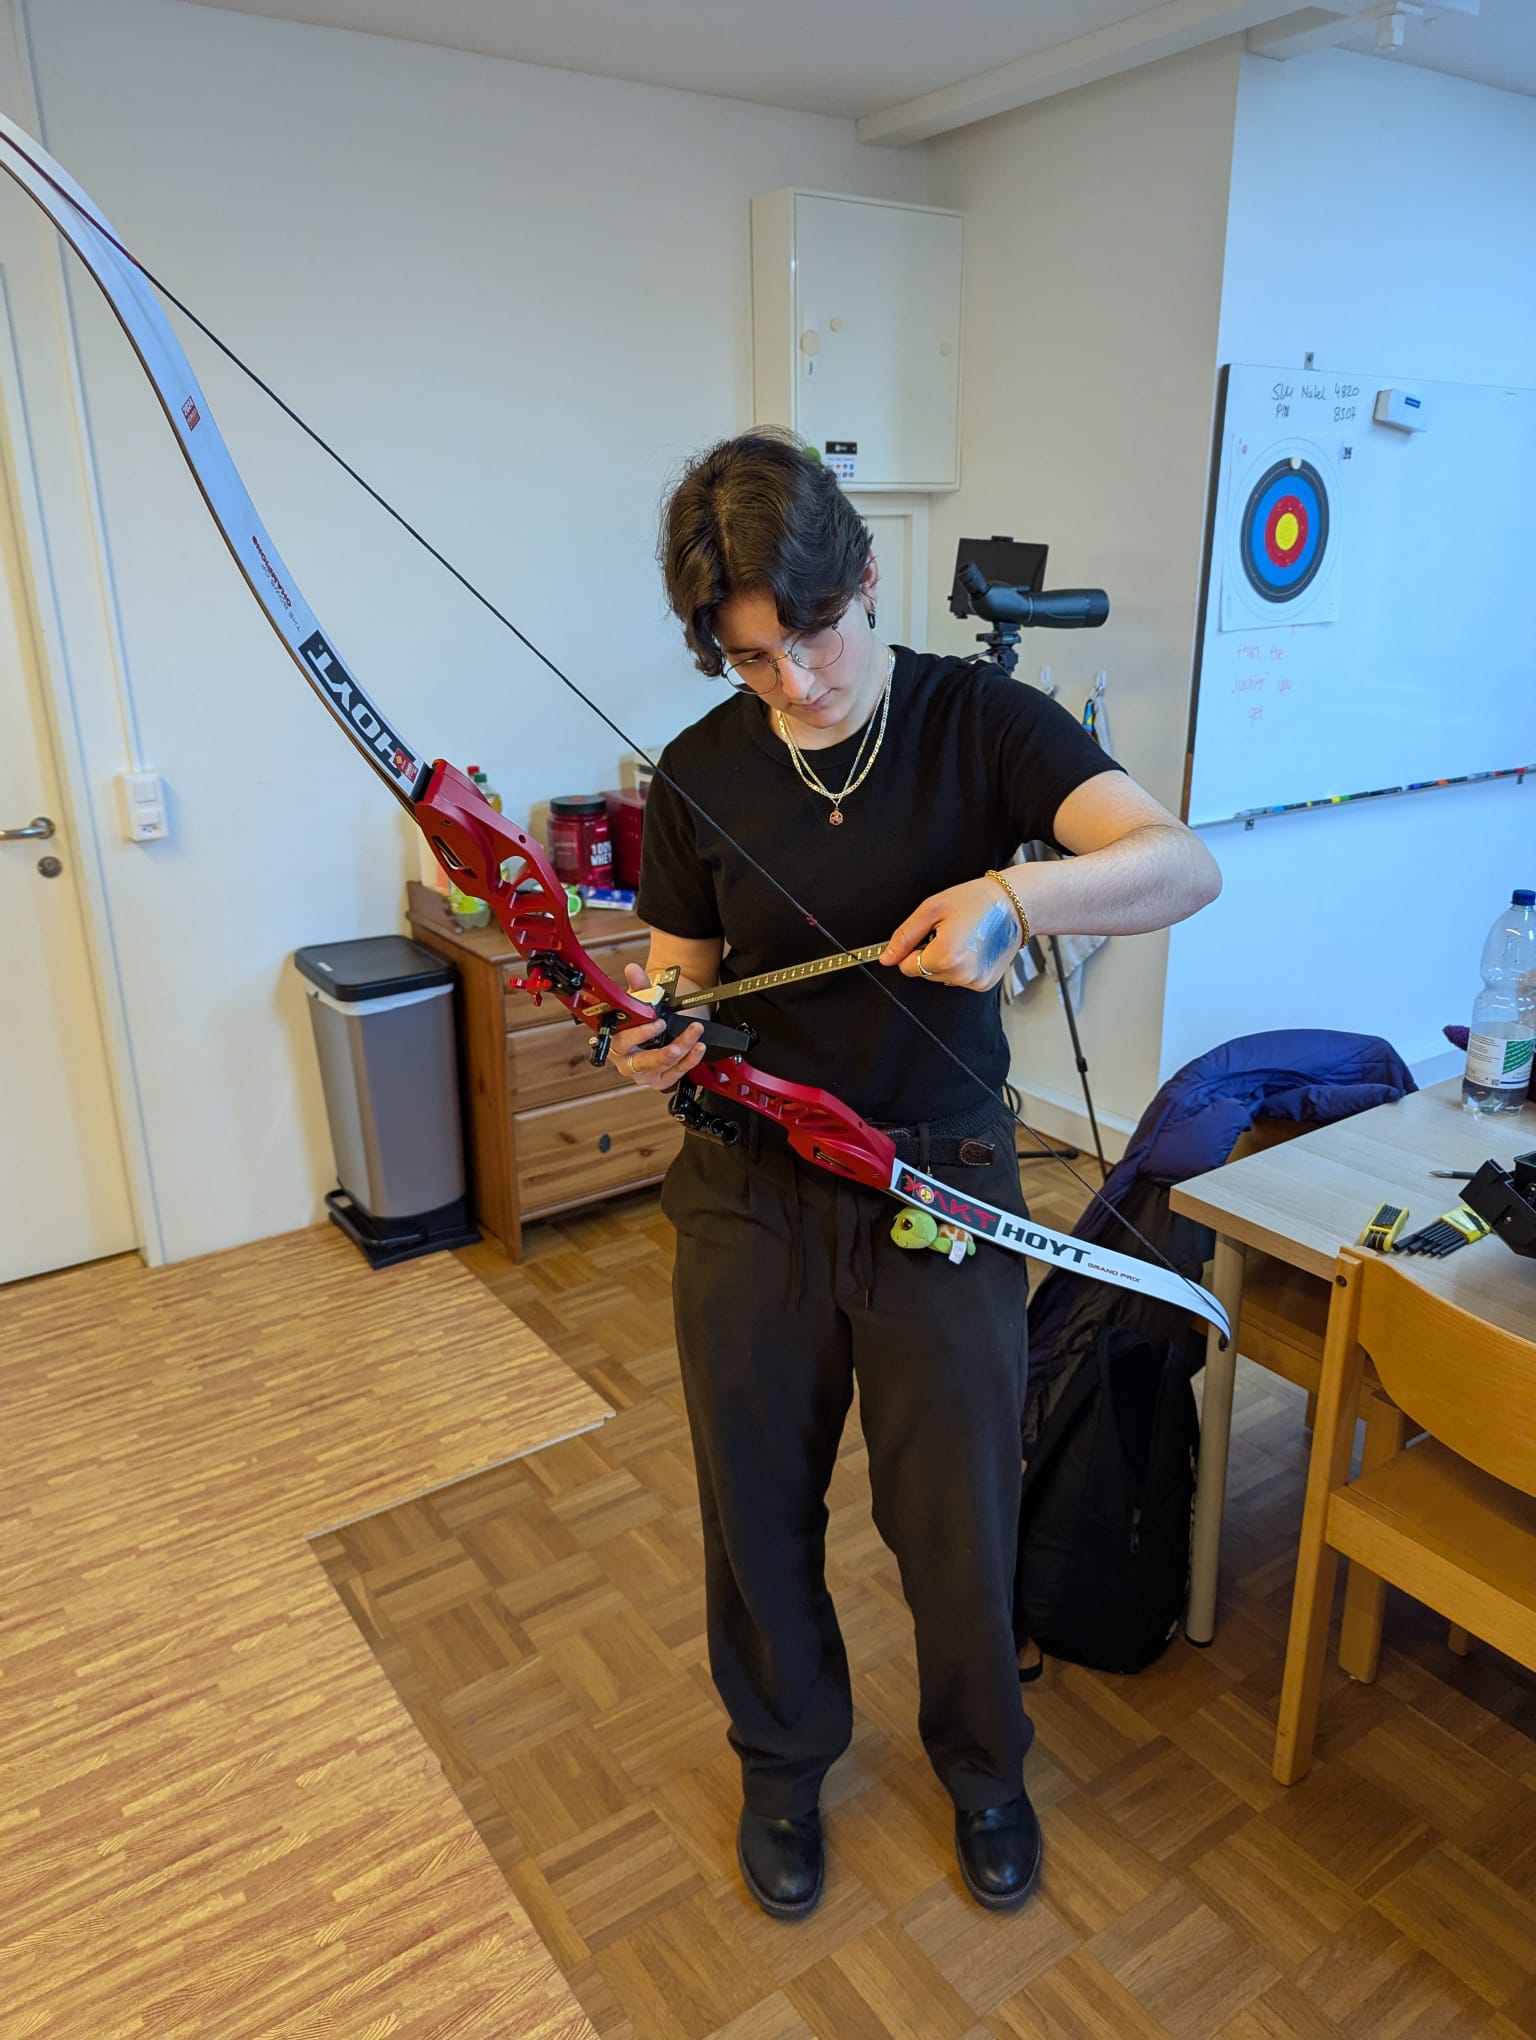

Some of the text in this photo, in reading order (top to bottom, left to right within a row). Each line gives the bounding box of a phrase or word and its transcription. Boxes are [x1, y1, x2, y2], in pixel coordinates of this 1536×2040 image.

[1334, 382, 1360, 399] 4820
[306, 649, 402, 770] HOYT
[590, 852, 613, 868] WHEY
[1002, 1222, 1092, 1264] HOYT
[1087, 1262, 1142, 1284] GRAND PRIX
